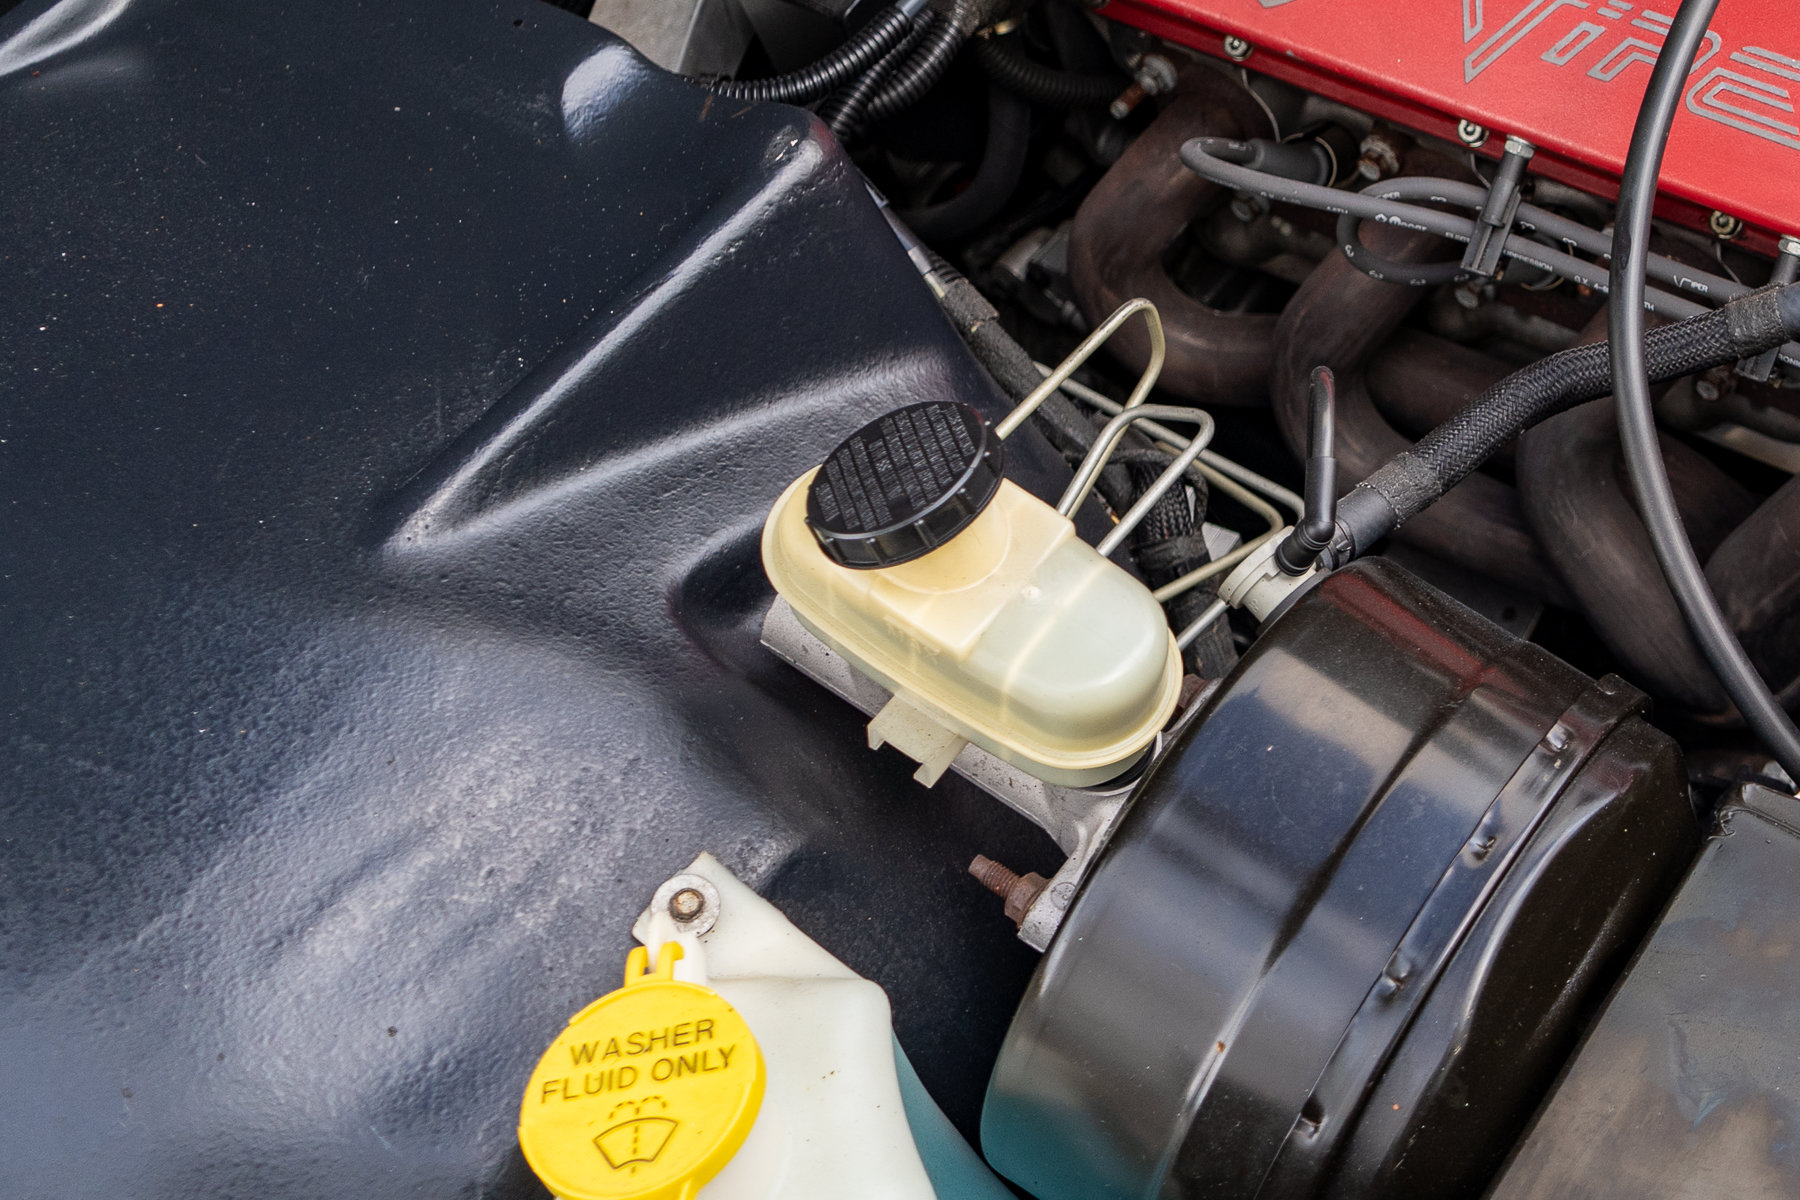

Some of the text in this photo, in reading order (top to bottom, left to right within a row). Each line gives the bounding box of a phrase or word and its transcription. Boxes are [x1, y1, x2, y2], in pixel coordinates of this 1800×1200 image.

[1502, 249, 1553, 272] UPPRESSION
[1673, 274, 1709, 294] VIPER
[569, 1018, 715, 1067] WASHER
[540, 1043, 736, 1105] FLUID ONLY
